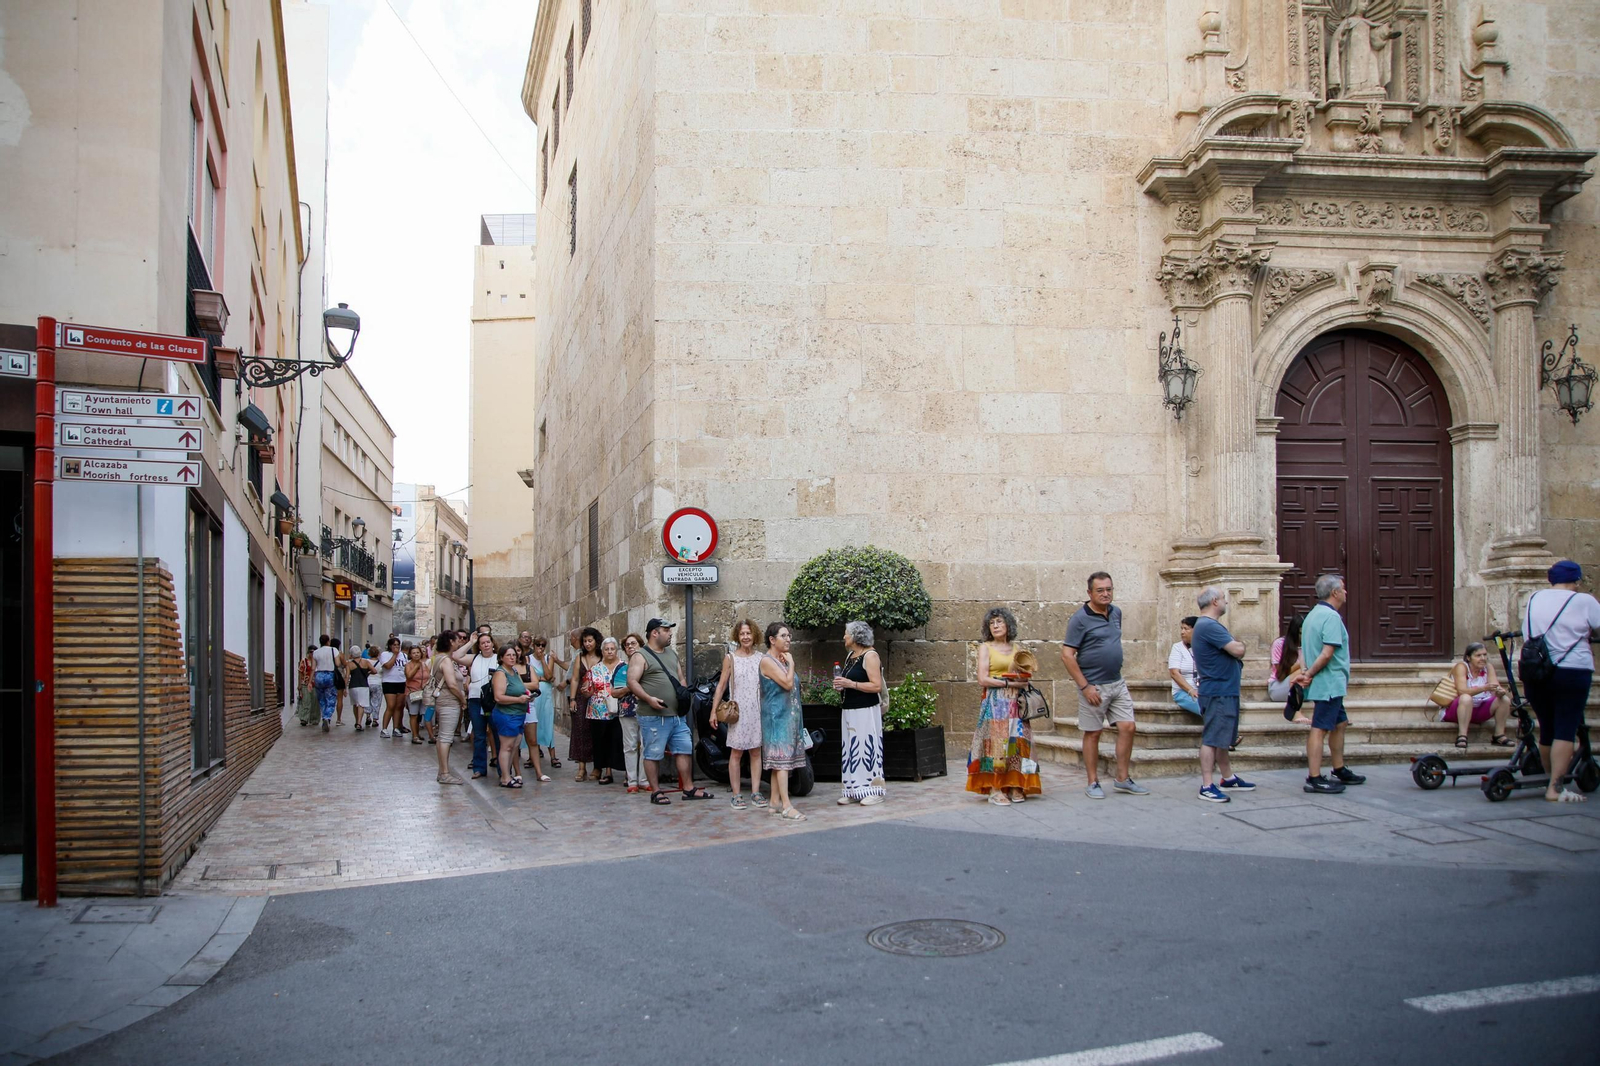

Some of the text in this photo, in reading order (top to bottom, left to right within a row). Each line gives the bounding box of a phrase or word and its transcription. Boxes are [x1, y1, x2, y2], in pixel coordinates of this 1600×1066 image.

[86, 334, 198, 354] Convento de las Claras
[85, 395, 151, 405] Ayuntamiento
[85, 405, 133, 415] Town hall
[83, 426, 126, 435] Catedral
[83, 437, 132, 446] Cathedral
[83, 460, 128, 469] Alcazaba
[83, 471, 168, 482] Moorish fortress
